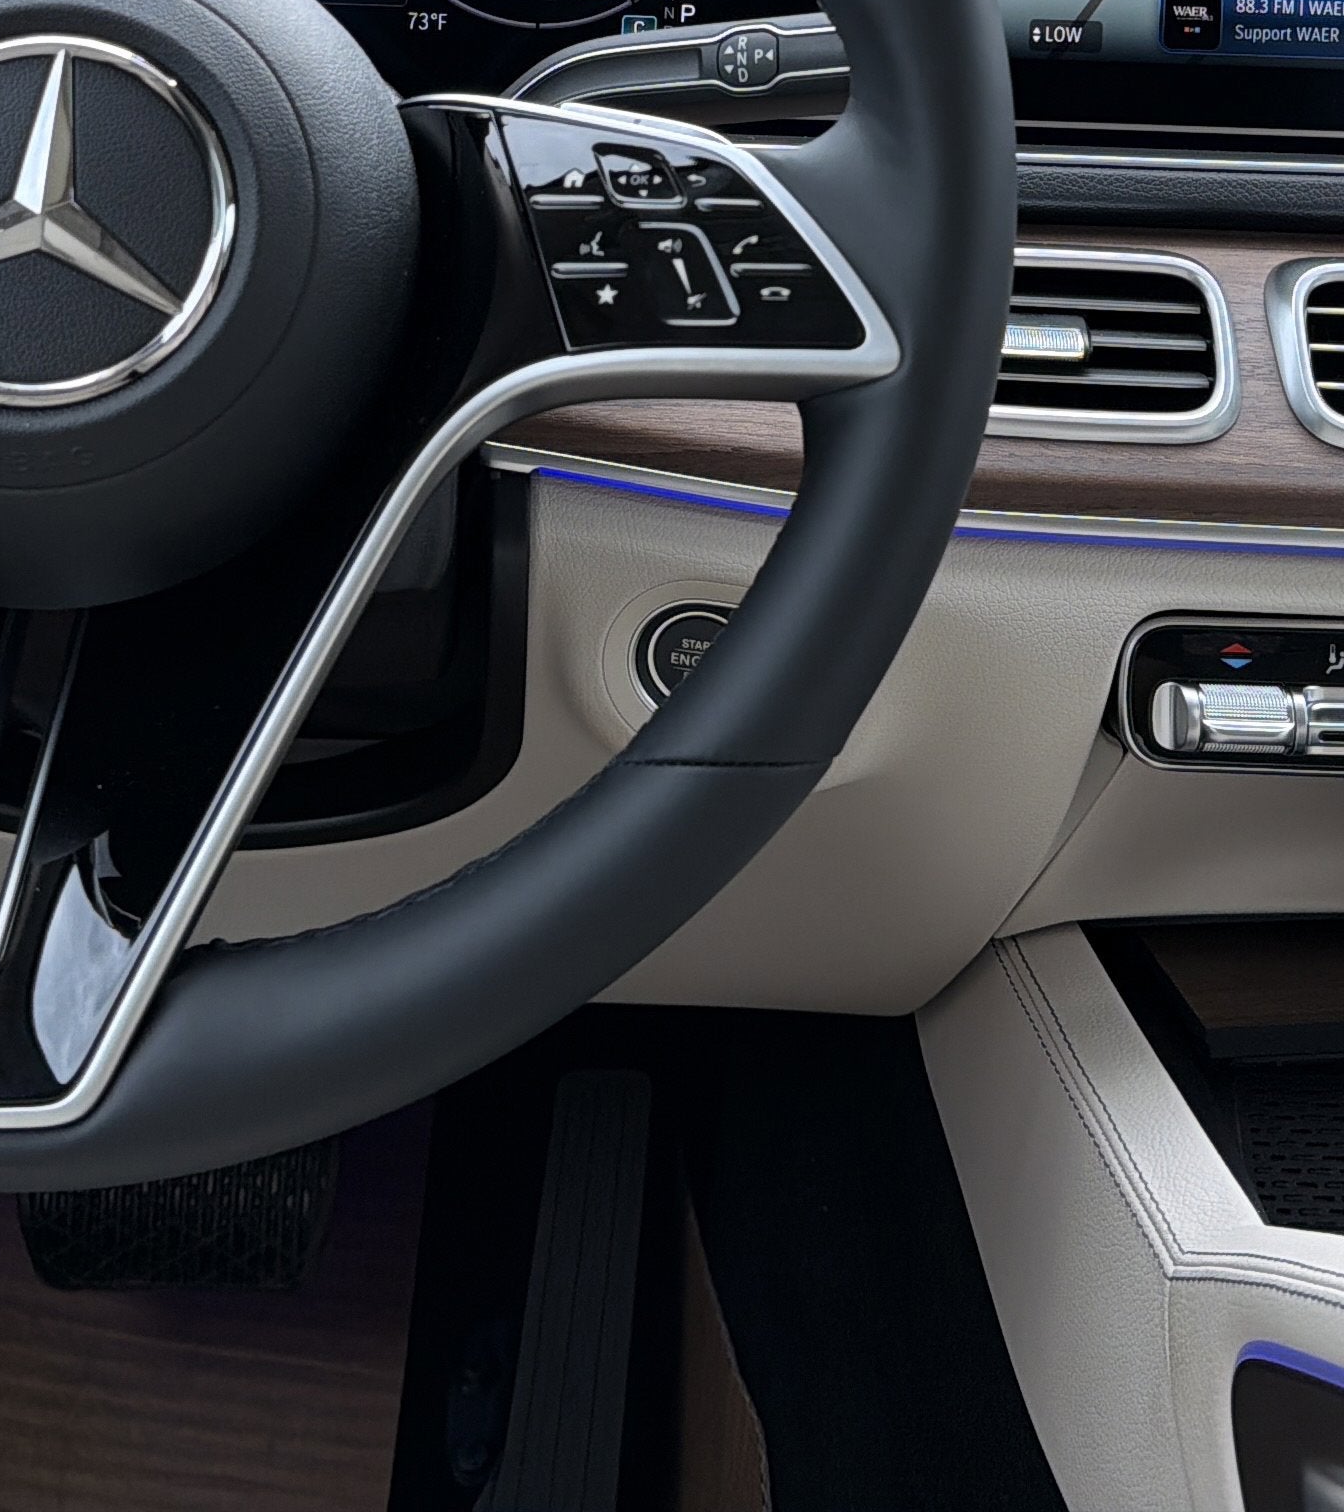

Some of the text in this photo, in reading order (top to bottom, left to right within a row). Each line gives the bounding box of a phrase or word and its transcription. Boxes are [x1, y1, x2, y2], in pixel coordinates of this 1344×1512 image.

[663, 6, 675, 20] N
[680, 4, 696, 23] P
[1172, 5, 1208, 18] WAER
[1273, 0, 1295, 15] FM
[407, 12, 448, 32] 73°F
[1044, 26, 1083, 44] LOW
[1234, 24, 1340, 45] Support WAER
[738, 36, 748, 51] R
[737, 52, 747, 66] N
[754, 49, 764, 64] P
[738, 67, 749, 83] D
[630, 174, 650, 186] OK
[681, 639, 711, 650] STAR
